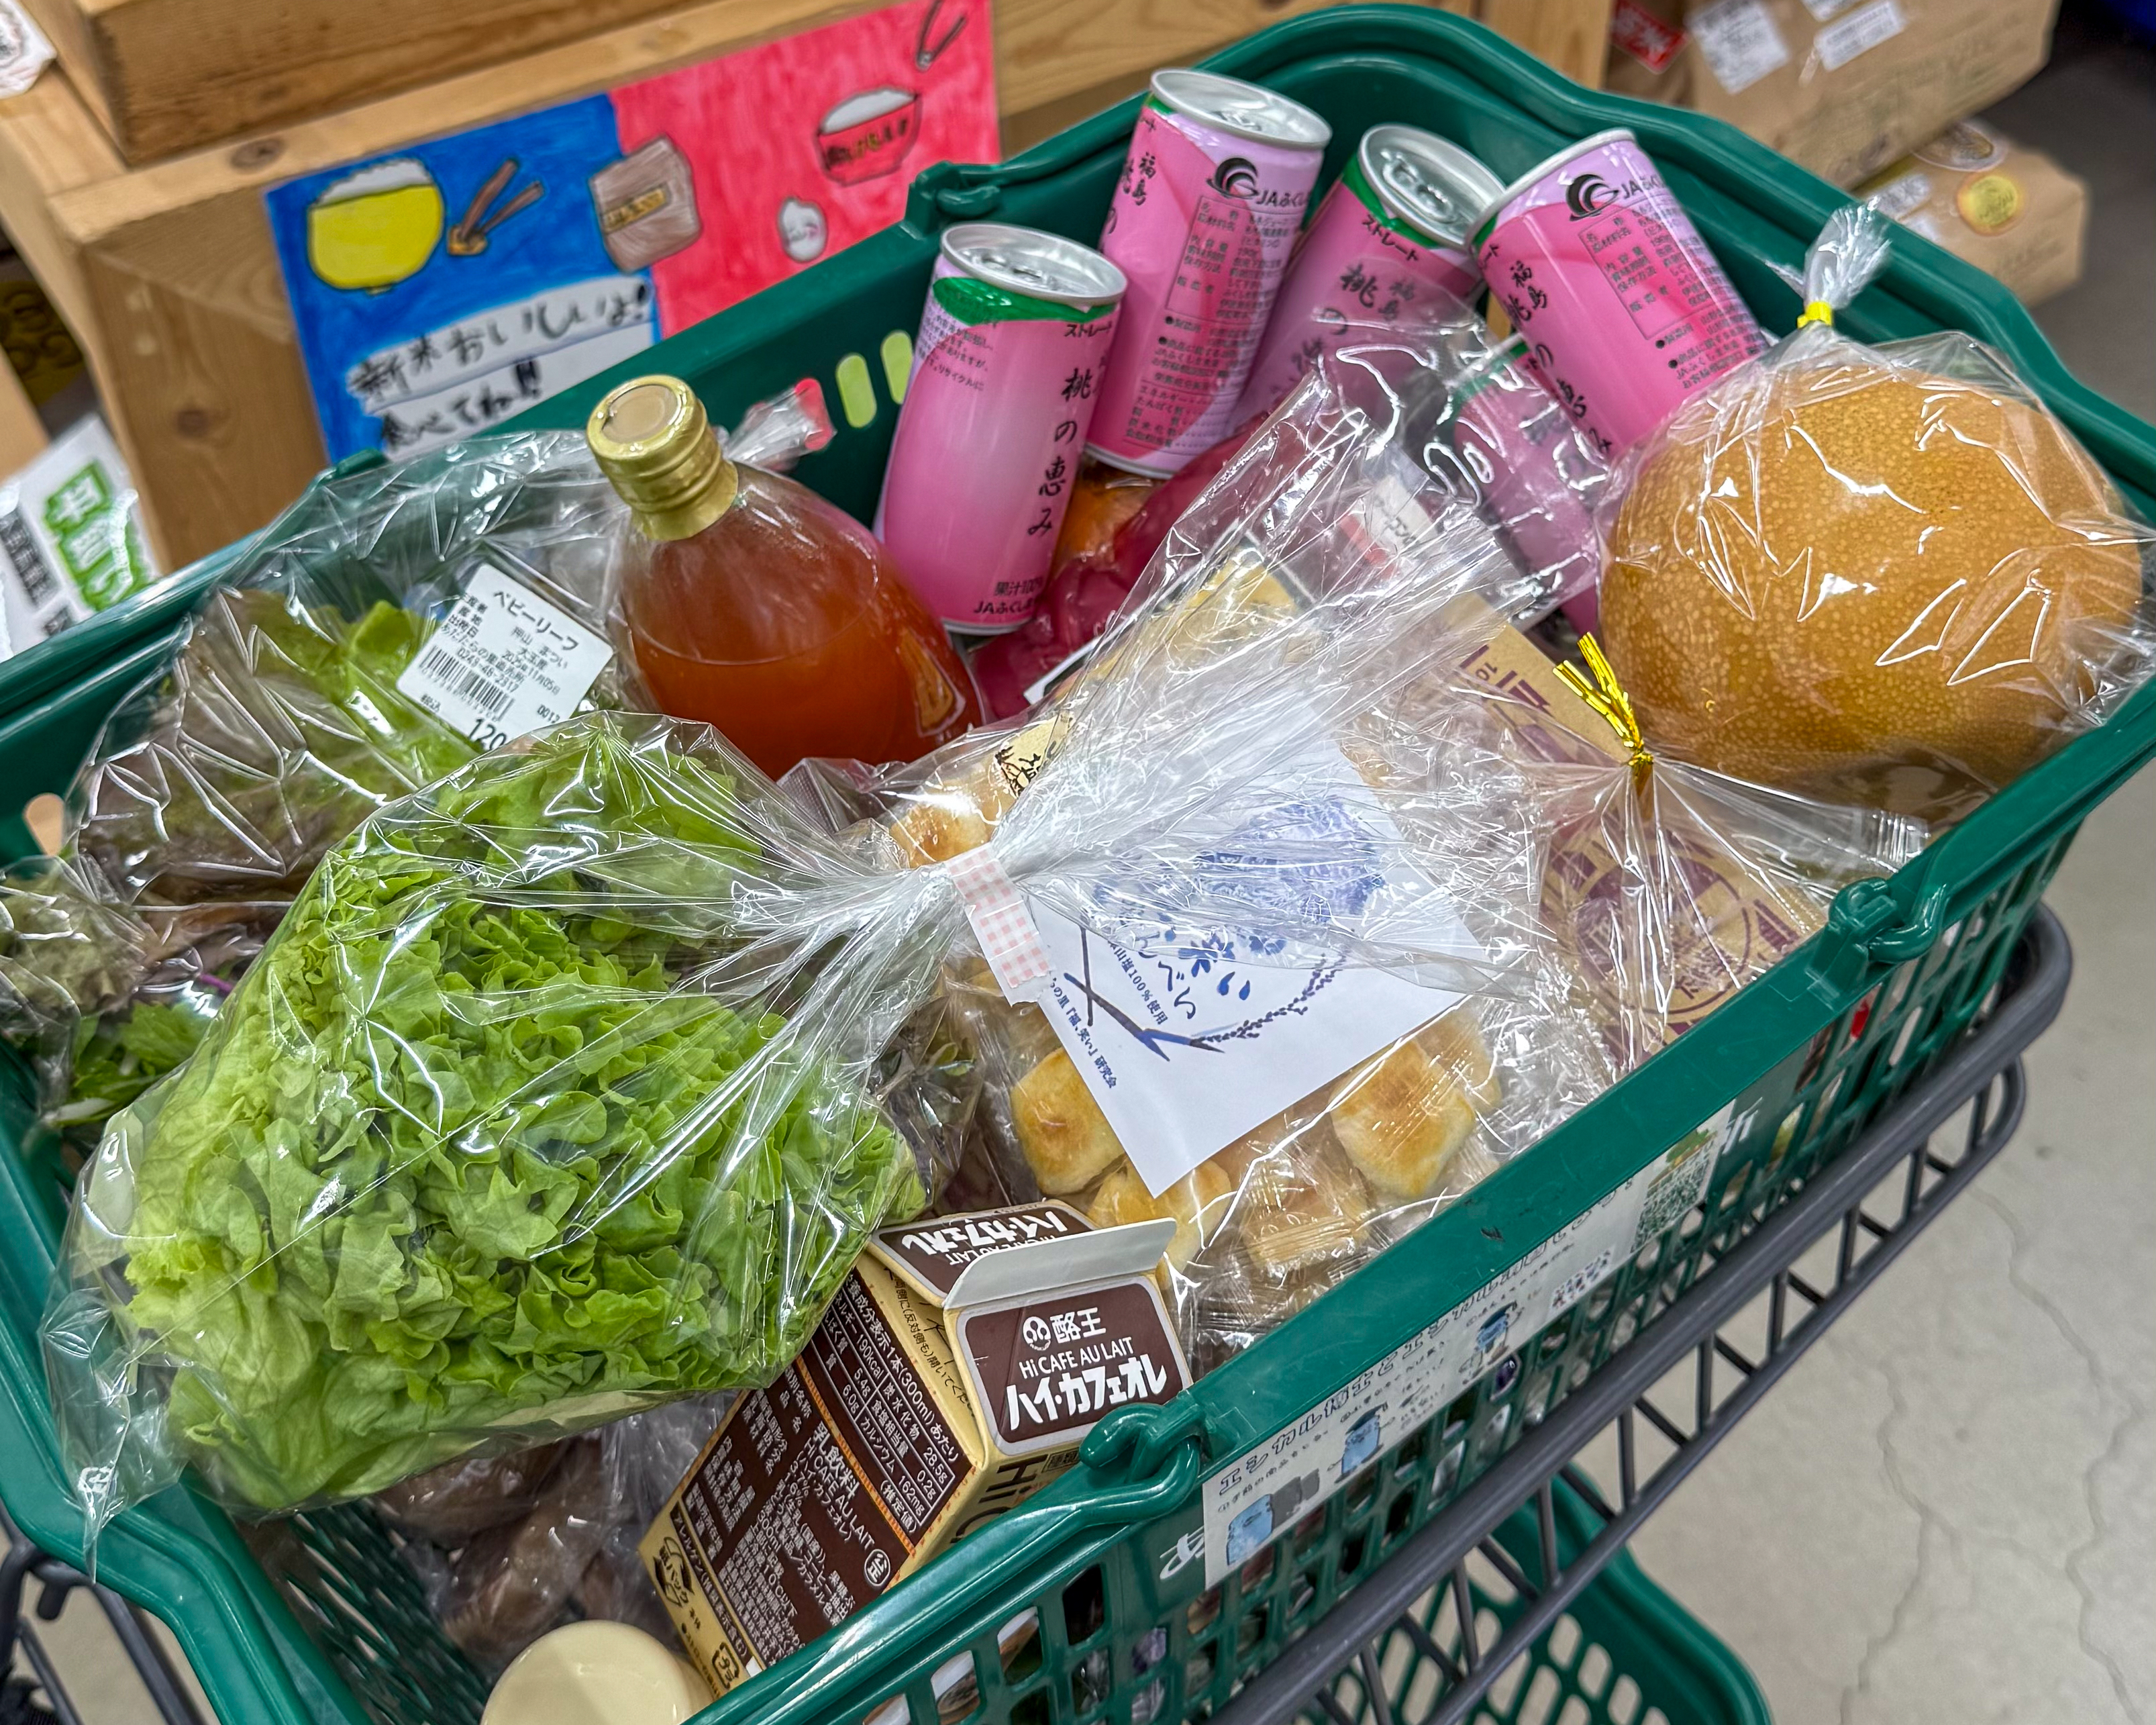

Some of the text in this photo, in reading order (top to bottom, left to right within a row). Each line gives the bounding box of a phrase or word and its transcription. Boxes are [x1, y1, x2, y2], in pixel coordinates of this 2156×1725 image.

[1362, 213, 1419, 261] ストレート
[1510, 260, 1548, 311] 福島
[1027, 368, 1094, 536] 桃の恵み
[493, 590, 579, 651] ベビーリーフ
[1050, 1308, 1106, 1342] 酪王
[854, 1332, 885, 1382] 190kcal
[1039, 1350, 1076, 1374] CAFE
[1080, 1345, 1101, 1366] AU
[1103, 1336, 1134, 1359] LAIT
[841, 1382, 862, 1416] 6.0g
[852, 1367, 872, 1399] 5.4g
[870, 1399, 937, 1501] 食塩相当量 0.2g
[882, 1382, 949, 1486] 炭水化物 28.5g
[788, 1459, 813, 1497] 3.7%
[809, 1420, 861, 1501] 乳飲料
[859, 1416, 926, 1518] カルシウム 162mg
[781, 1471, 805, 1507] 1.6%
[811, 1454, 839, 1495] CAFE
[834, 1492, 854, 1520] AU
[848, 1514, 874, 1552] LAIT
[878, 1478, 918, 1536] (推定値)
[755, 1510, 782, 1553] 300ml
